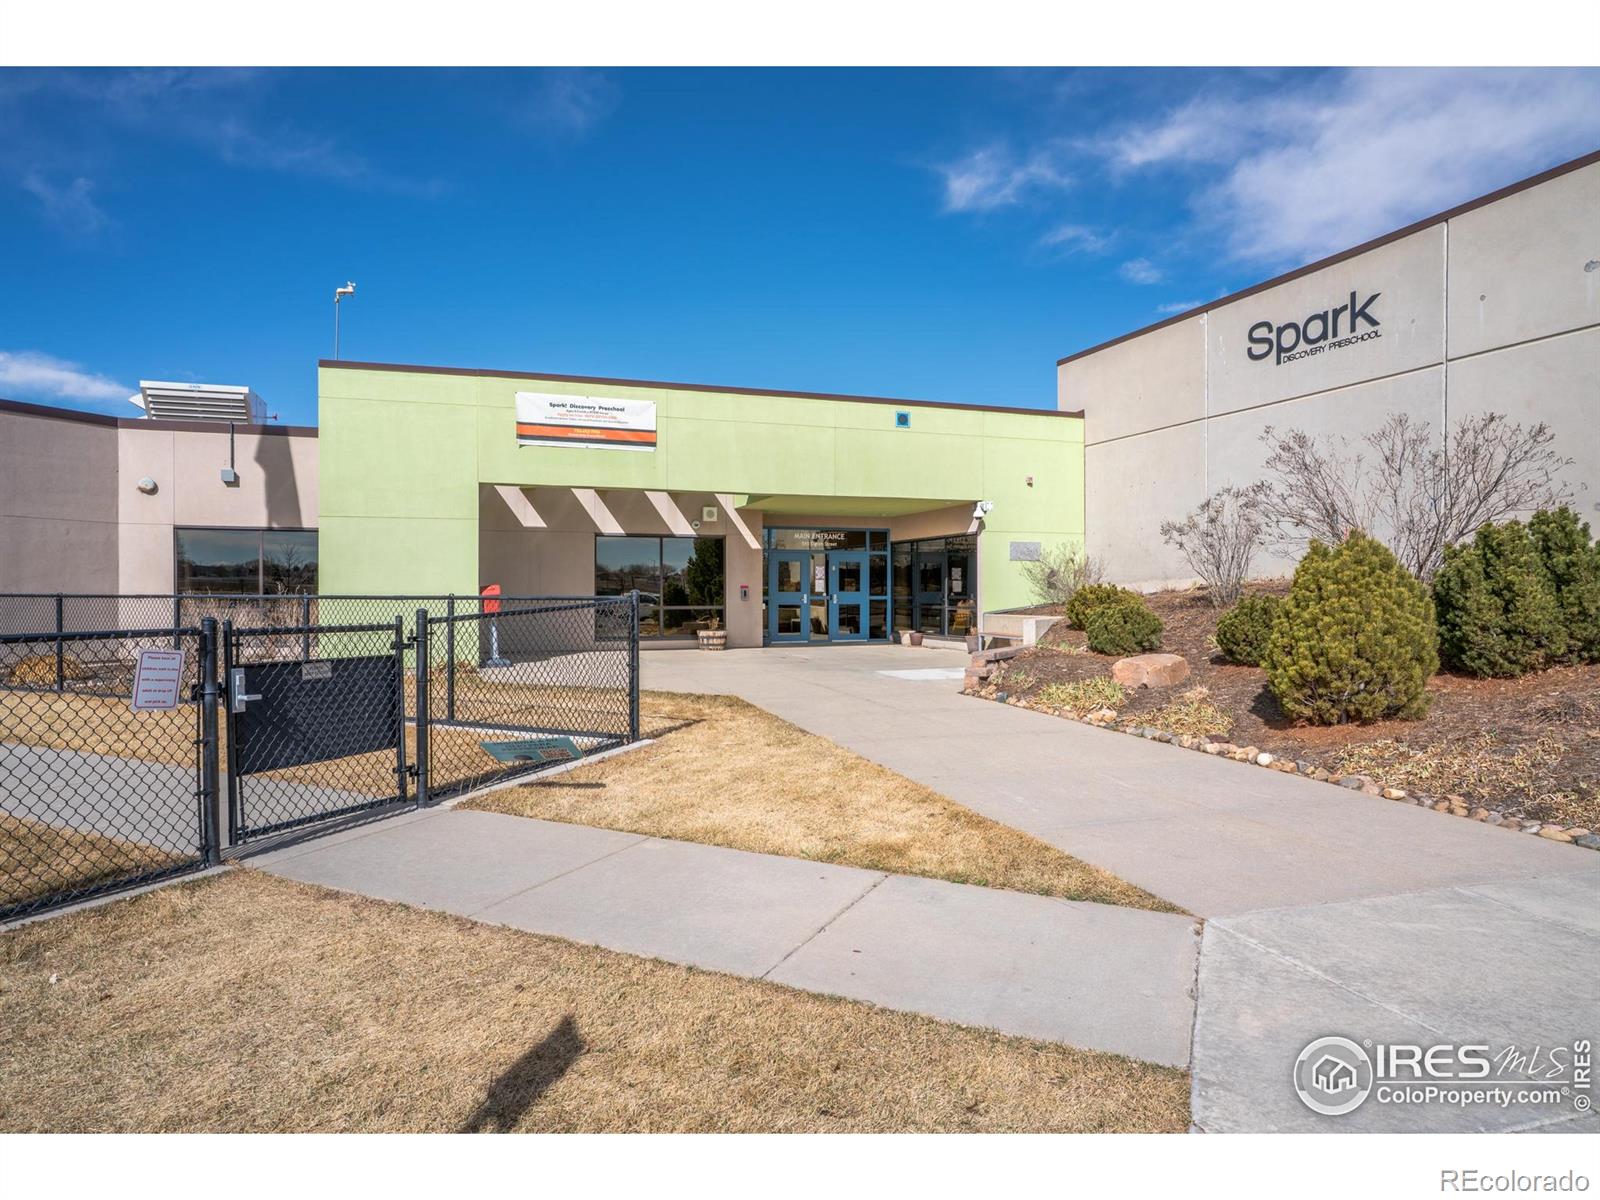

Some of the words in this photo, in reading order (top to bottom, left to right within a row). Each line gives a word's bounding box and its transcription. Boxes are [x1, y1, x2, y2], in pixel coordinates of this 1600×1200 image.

[1247, 291, 1382, 366] Spark
[1283, 344, 1327, 363] DISCOVERY
[1329, 330, 1382, 350] PRESCHOOL
[569, 403, 596, 411] Discovery
[811, 532, 846, 540] ENTRANCE
